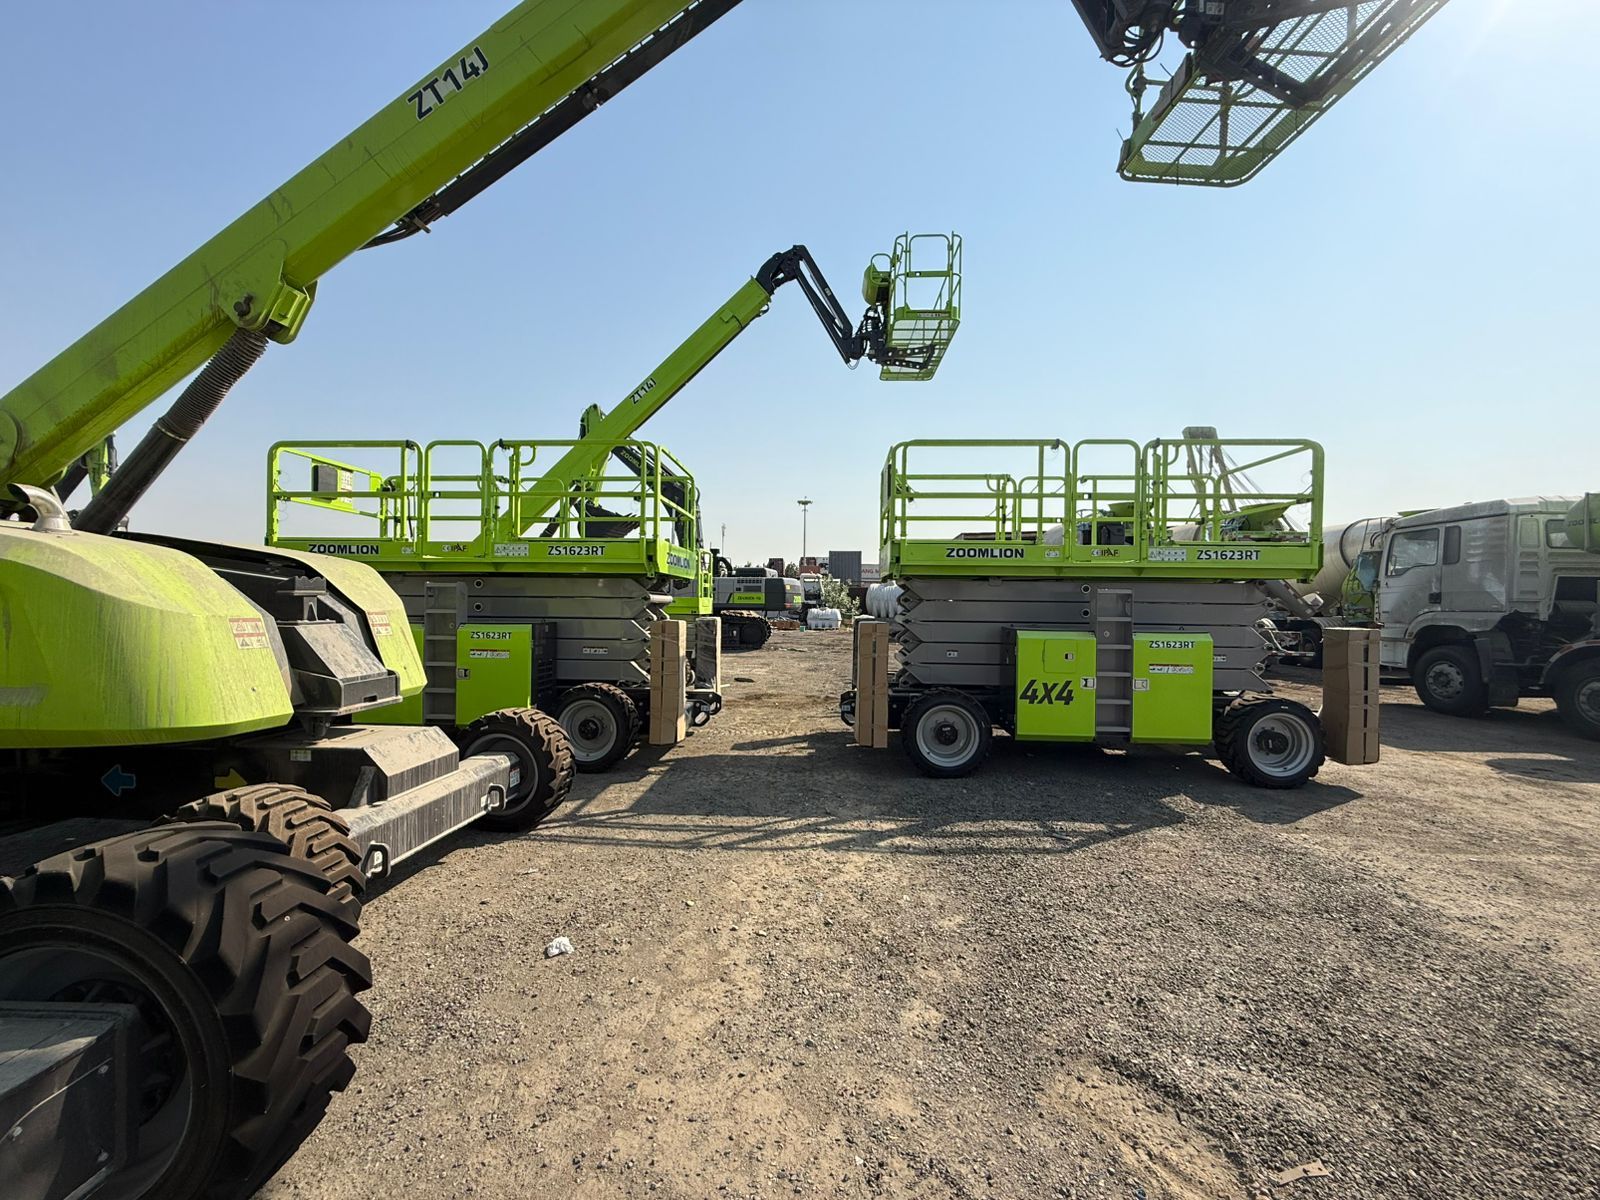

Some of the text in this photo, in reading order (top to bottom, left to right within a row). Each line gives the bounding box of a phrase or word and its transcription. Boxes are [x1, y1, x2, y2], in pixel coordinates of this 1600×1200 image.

[406, 46, 489, 120] ZT14J
[629, 377, 657, 405] ZT14J
[308, 543, 379, 554] ZOOMLION
[547, 545, 605, 556] ZS1623RT
[945, 547, 1025, 558] ZOOMLION
[1196, 549, 1261, 560] ZS1623RT
[470, 631, 512, 640] ZS1623RT
[1149, 640, 1195, 649] ZS1623RT
